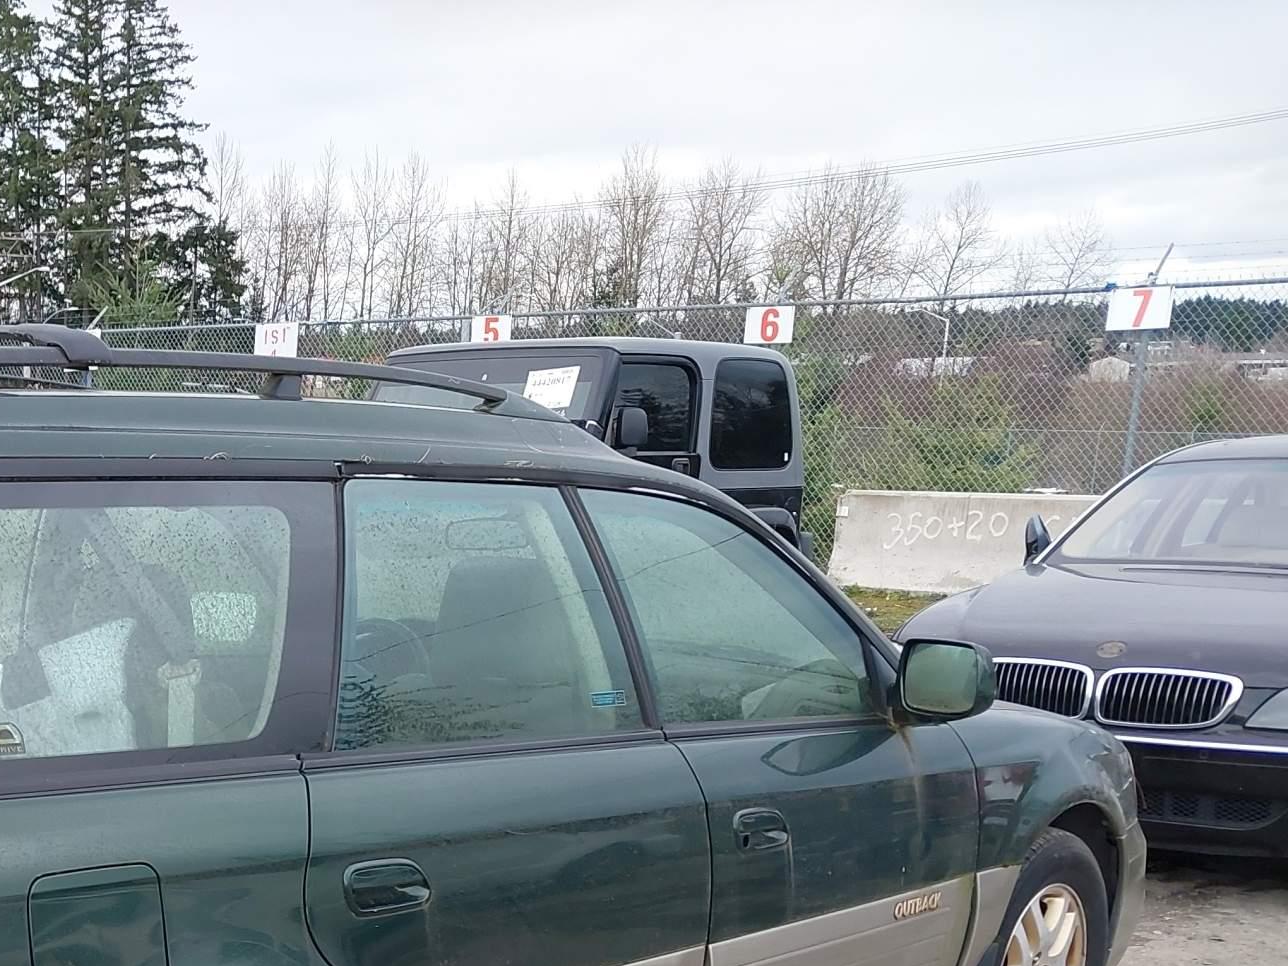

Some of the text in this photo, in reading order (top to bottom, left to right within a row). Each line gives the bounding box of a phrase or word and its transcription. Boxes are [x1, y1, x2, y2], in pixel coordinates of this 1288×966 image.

[1132, 289, 1153, 327] 7
[483, 317, 500, 341] 5
[760, 308, 780, 342] 6
[894, 891, 943, 921] OUTBACK
